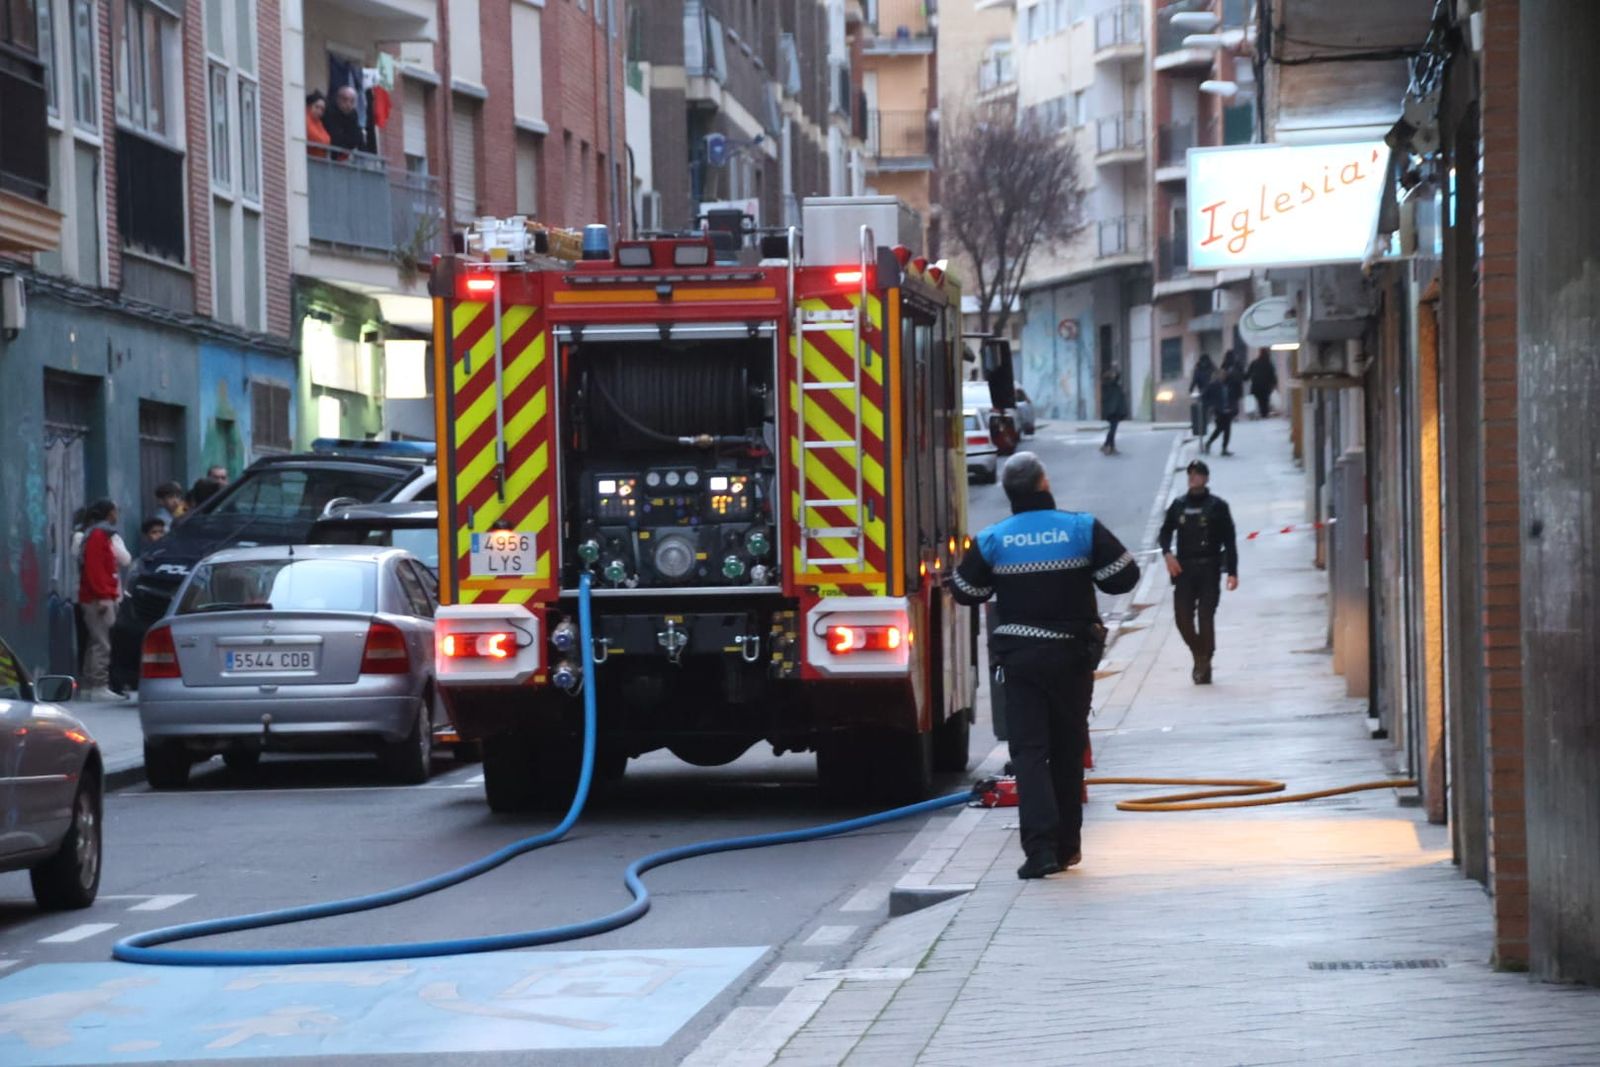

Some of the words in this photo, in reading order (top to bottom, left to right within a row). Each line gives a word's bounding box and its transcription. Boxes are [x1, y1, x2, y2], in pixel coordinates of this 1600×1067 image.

[484, 535, 530, 552] 4956
[1002, 526, 1070, 549] POLICÍA
[488, 555, 523, 572] LYS
[234, 652, 274, 669] 5544
[280, 652, 310, 669] CDB
